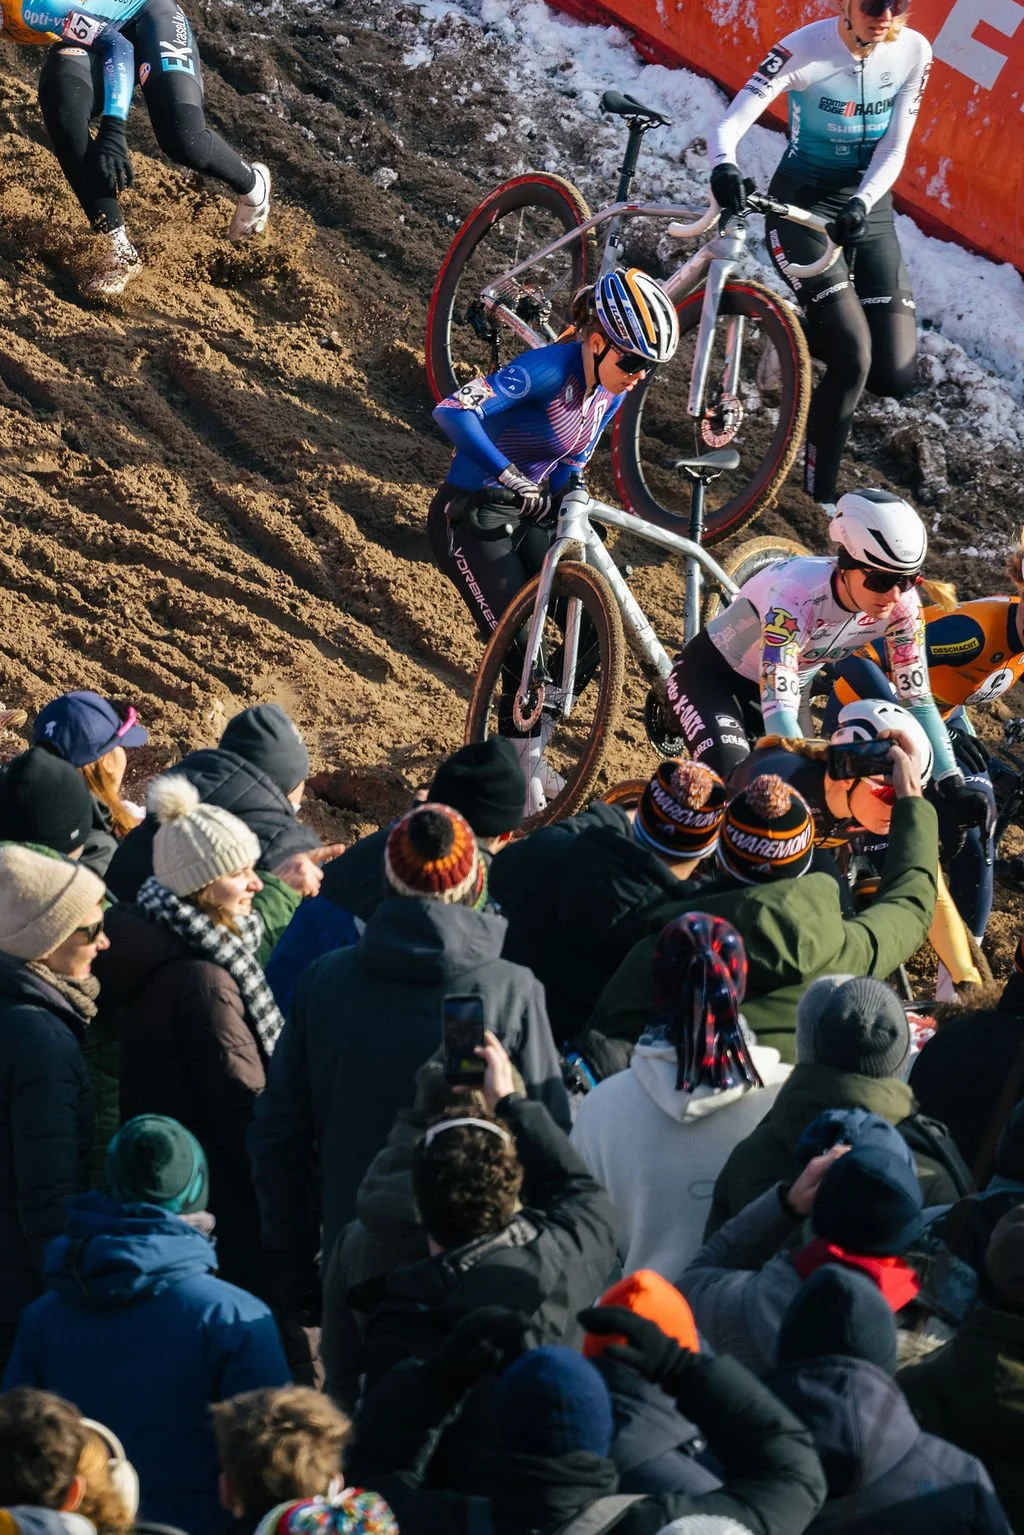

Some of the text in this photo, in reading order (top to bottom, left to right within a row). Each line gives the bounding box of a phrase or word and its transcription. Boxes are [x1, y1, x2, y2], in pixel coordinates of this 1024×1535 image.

[74, 16, 94, 38] 67
[763, 52, 782, 74] 73
[855, 96, 894, 116] RACIN
[453, 546, 498, 632] VORBIKES
[932, 639, 979, 655] DESCHACHT
[776, 675, 799, 694] 30
[898, 669, 924, 691] 30
